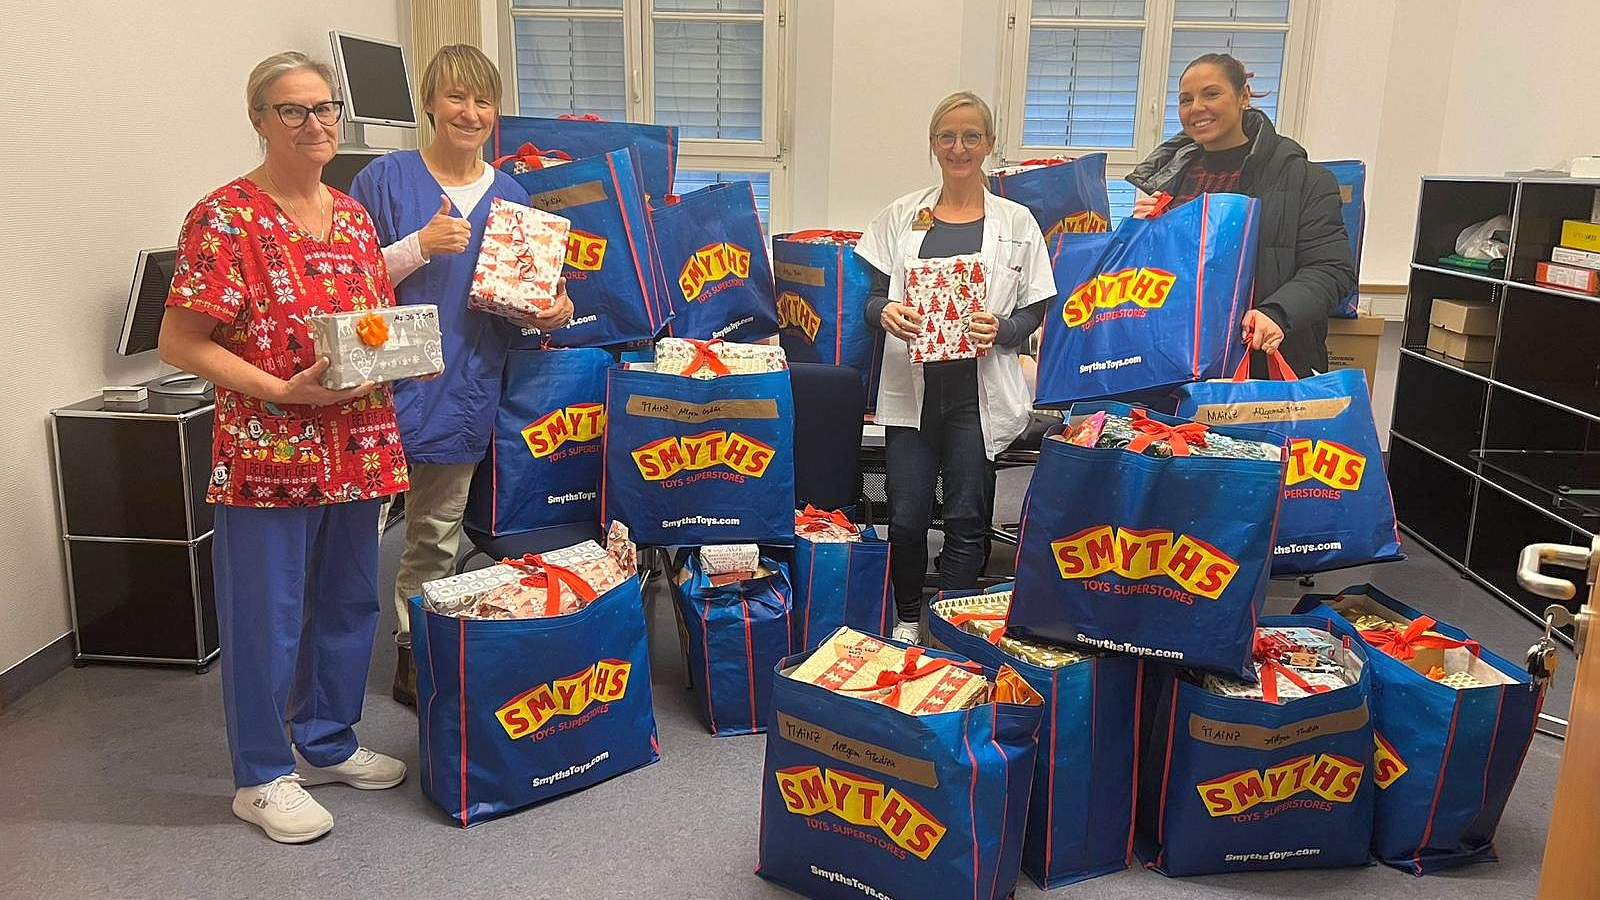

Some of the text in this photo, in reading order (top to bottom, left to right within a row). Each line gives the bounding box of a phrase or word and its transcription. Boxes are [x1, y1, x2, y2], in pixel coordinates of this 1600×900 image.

[681, 249, 748, 297] SMYTHS
[528, 410, 602, 453] SMYT
[548, 444, 601, 463] TOYS SUPERST
[639, 437, 769, 476] SMYTHS
[1291, 448, 1362, 485] THS
[547, 491, 597, 505] SmythsToys
[661, 471, 745, 489] TOYS SUPERSTORES
[1284, 488, 1341, 500] PERSTORES
[662, 515, 740, 528] SmythsToys.com
[1058, 533, 1231, 593] SMYTHS
[1274, 542, 1342, 555] thsToys.com
[1082, 580, 1195, 606] TOYS SUPERSTORES
[1076, 633, 1184, 660] SmythsToys.com
[504, 668, 627, 734] SMYTHS
[530, 703, 609, 743] TOYS SUPERSTORES
[532, 751, 609, 787] SmythsToys.com
[1206, 761, 1359, 811] SMYTHS
[781, 774, 938, 853] SMYTHS
[1231, 799, 1333, 823] TOYS SUPERSTORES
[805, 818, 907, 860] TOYS SUPERSTORES
[1225, 848, 1320, 862] SmythsToys.com
